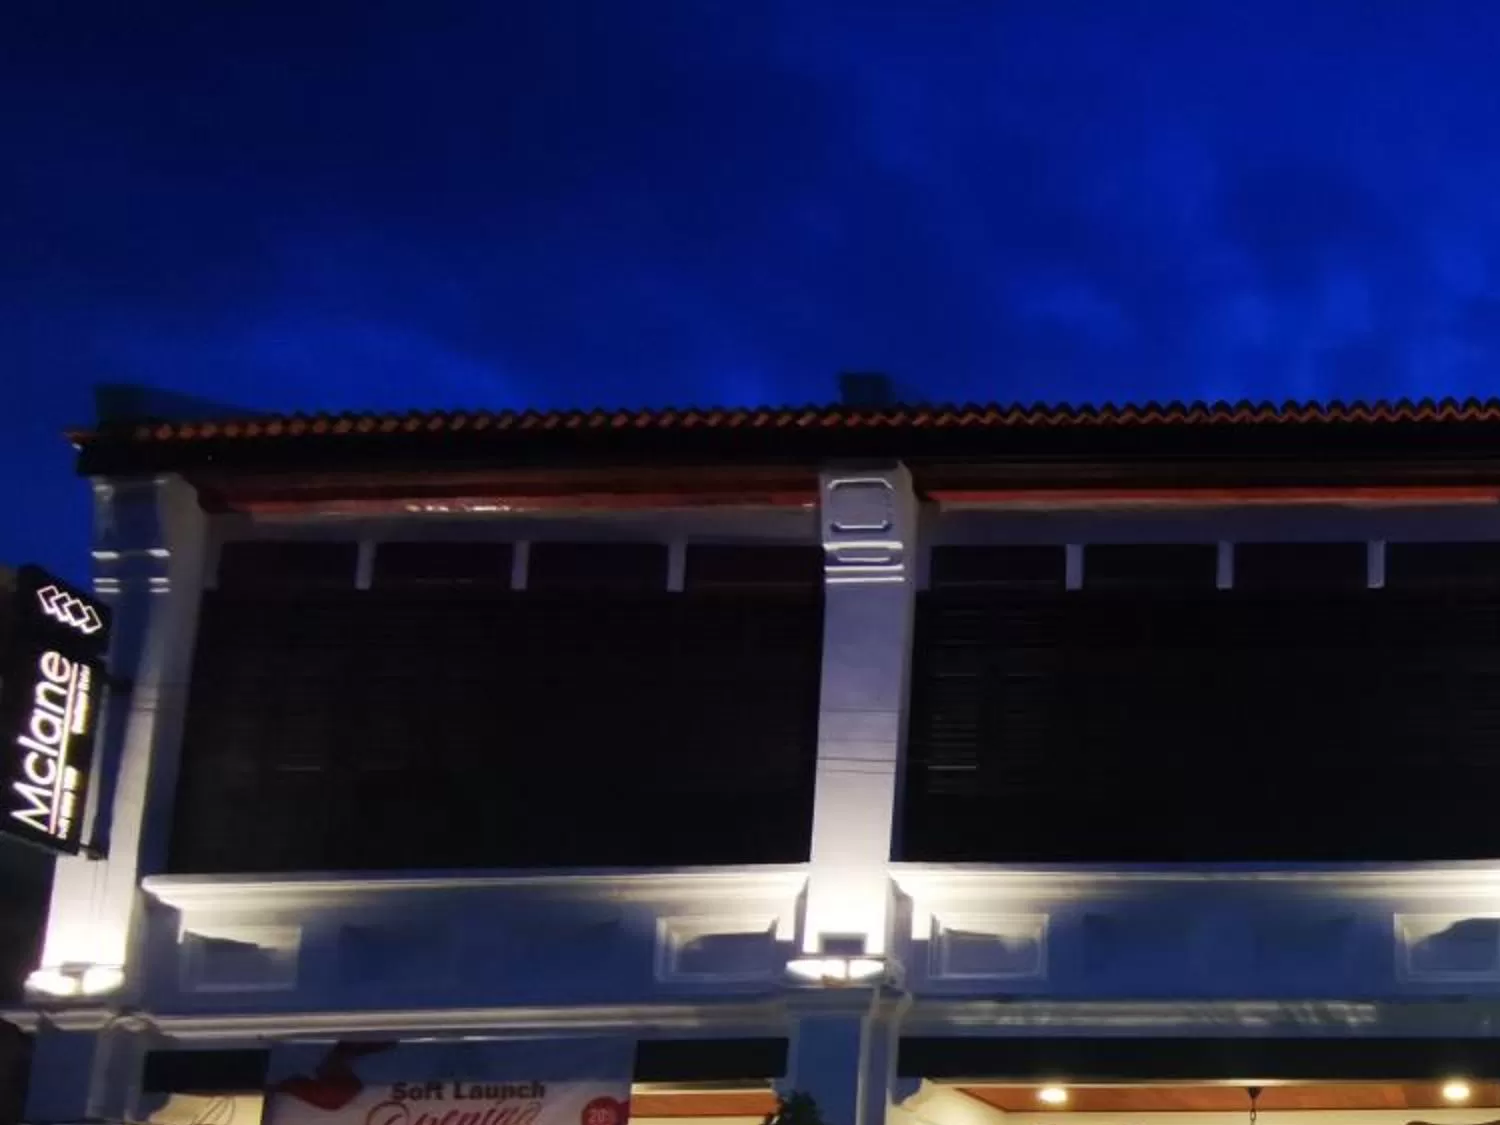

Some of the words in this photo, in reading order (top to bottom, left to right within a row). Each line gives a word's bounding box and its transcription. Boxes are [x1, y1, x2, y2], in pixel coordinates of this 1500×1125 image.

[10, 650, 71, 833] Mclane
[391, 1080, 445, 1101] Soft
[453, 1078, 546, 1101] Launch
